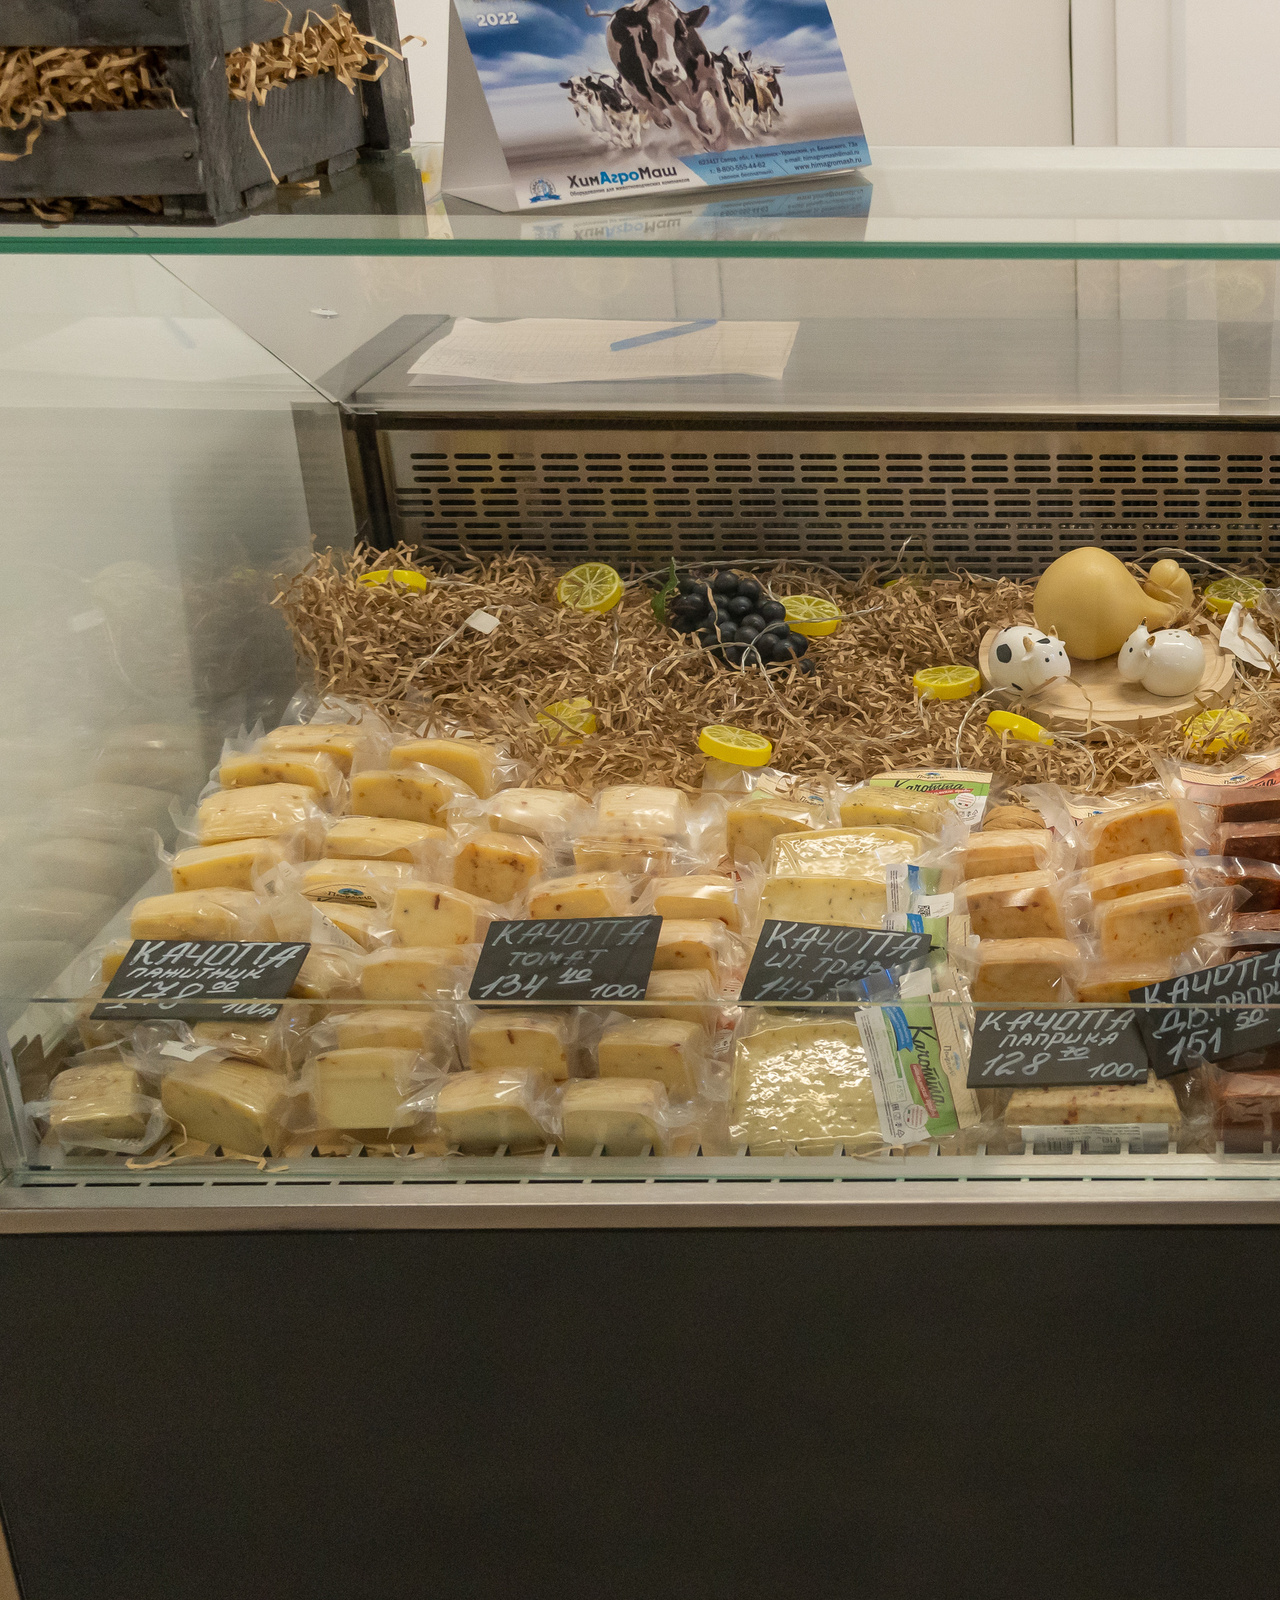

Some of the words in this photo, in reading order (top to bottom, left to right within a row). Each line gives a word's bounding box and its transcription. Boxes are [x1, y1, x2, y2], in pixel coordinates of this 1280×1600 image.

[476, 12, 518, 27] 2022
[716, 162, 766, 173] 8-800-555-44-62
[794, 157, 862, 171] www.himagromash.ru
[567, 166, 677, 189] ХимАгроМаш
[492, 919, 653, 946] КАЧОТТА
[765, 922, 922, 959] КАЧОТТА
[128, 940, 305, 968] КАЧОТТА
[509, 949, 609, 967] ТОМАТ
[126, 966, 262, 980] ПАЖИТНИК
[479, 974, 548, 998] 134
[557, 967, 593, 984] 40
[206, 981, 239, 993] 00
[755, 976, 823, 999] 145
[978, 1008, 1136, 1032] КАЧОТТА
[999, 1032, 1120, 1050] ПАПРИКА
[1167, 1027, 1222, 1066] 151
[1234, 1010, 1269, 1031] 50
[982, 1051, 1052, 1077] 128
[1057, 1047, 1089, 1061] 70
